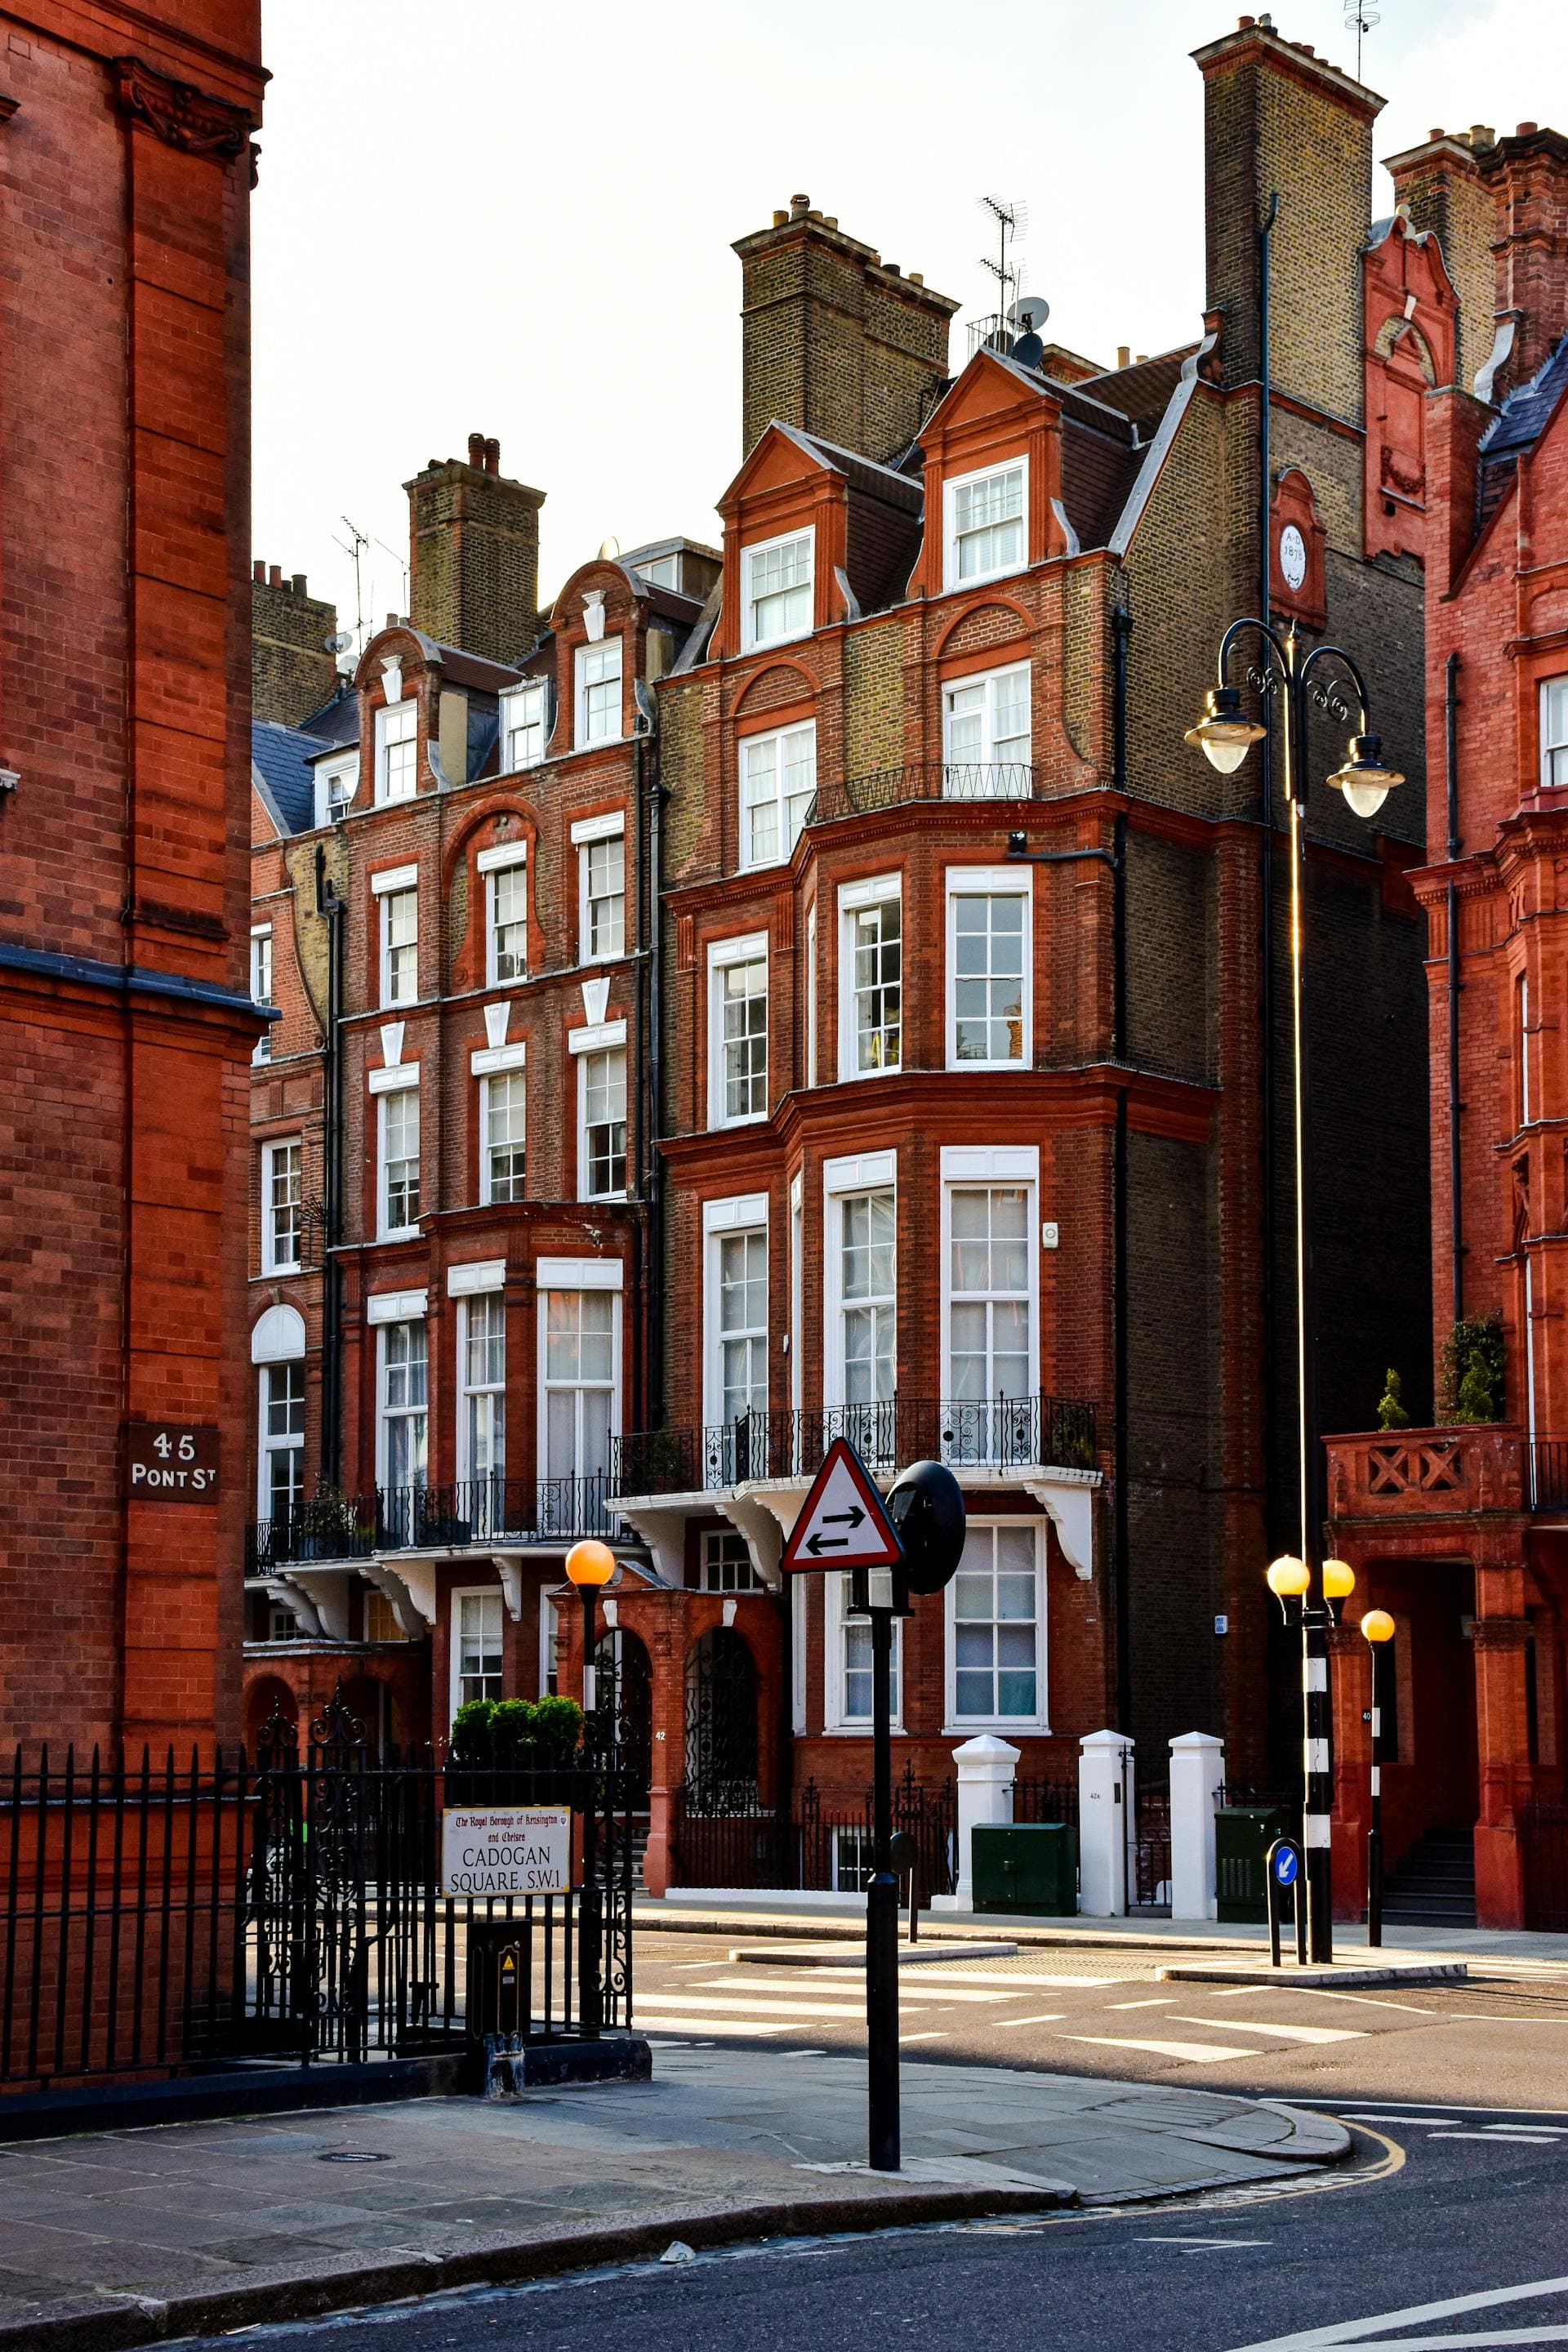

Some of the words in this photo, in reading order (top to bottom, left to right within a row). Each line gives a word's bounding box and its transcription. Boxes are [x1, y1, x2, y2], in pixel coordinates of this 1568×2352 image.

[1284, 546, 1303, 563] 1878
[153, 1432, 195, 1460] 45
[131, 1463, 188, 1487] PONT
[1363, 1712, 1371, 1721] 40
[656, 1731, 666, 1740] 42
[456, 1816, 468, 1828] The
[470, 1816, 488, 1829] Royal
[489, 1815, 514, 1829] Borough
[516, 1815, 523, 1825] of
[525, 1814, 558, 1828] Kensington
[488, 1832, 499, 1842] and
[501, 1832, 526, 1842] Chelsea
[462, 1846, 550, 1867] CADOGAN
